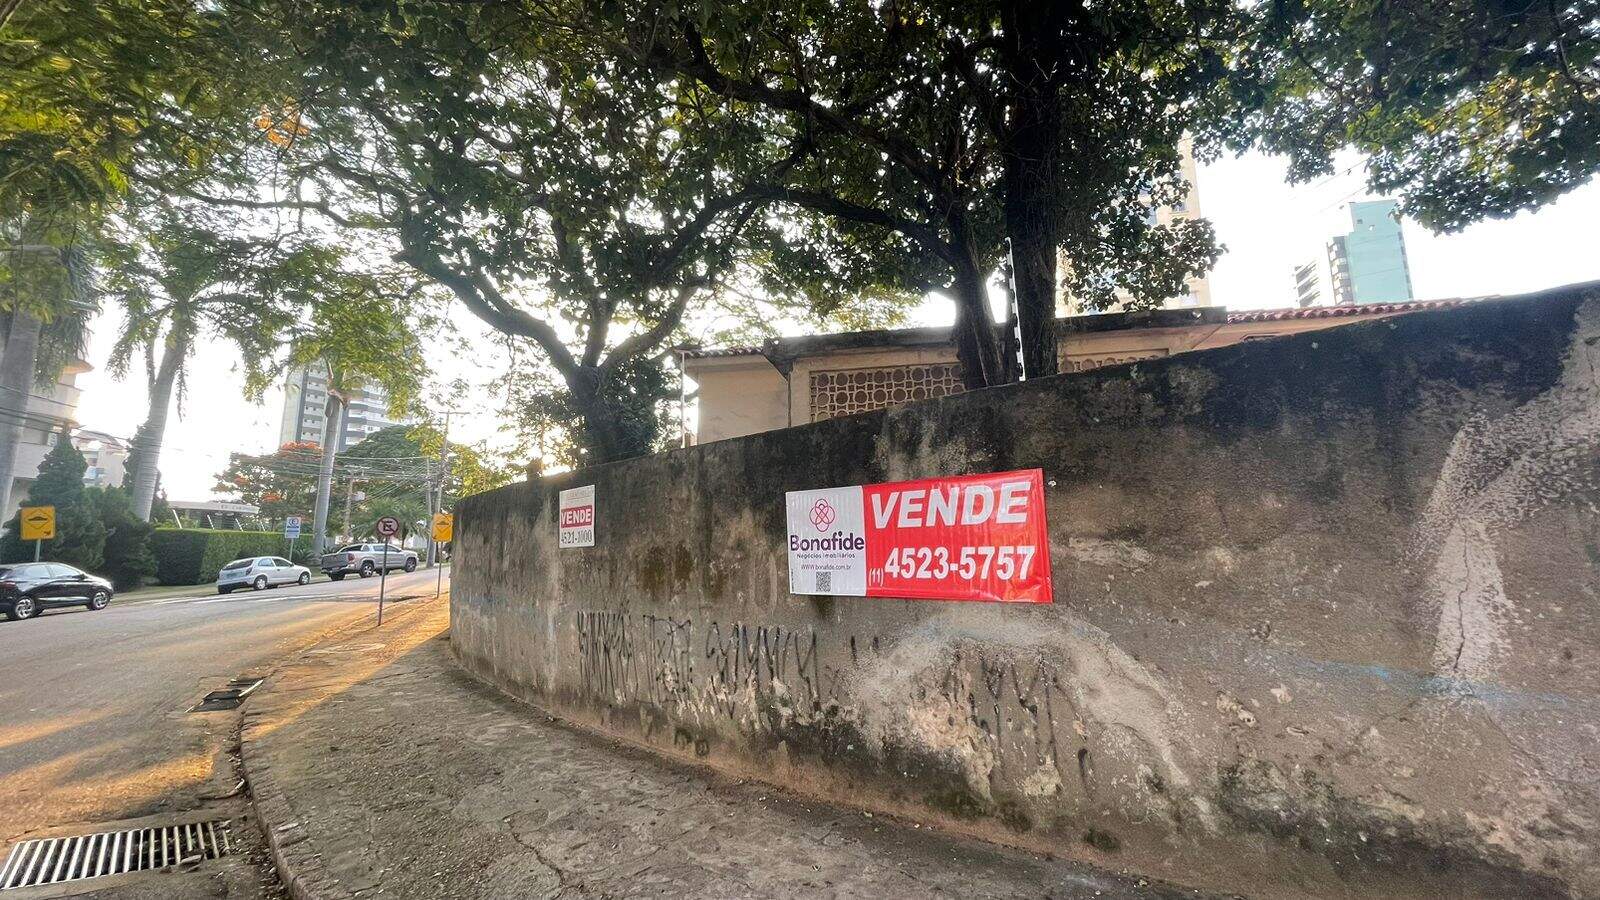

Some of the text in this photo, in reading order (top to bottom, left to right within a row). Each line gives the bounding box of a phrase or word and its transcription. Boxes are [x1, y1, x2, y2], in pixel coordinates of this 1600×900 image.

[561, 509, 591, 525] VENDE
[870, 482, 1031, 529] VENDE
[790, 531, 865, 551] Bonafide
[868, 545, 1036, 587] (11) 4523-5757
